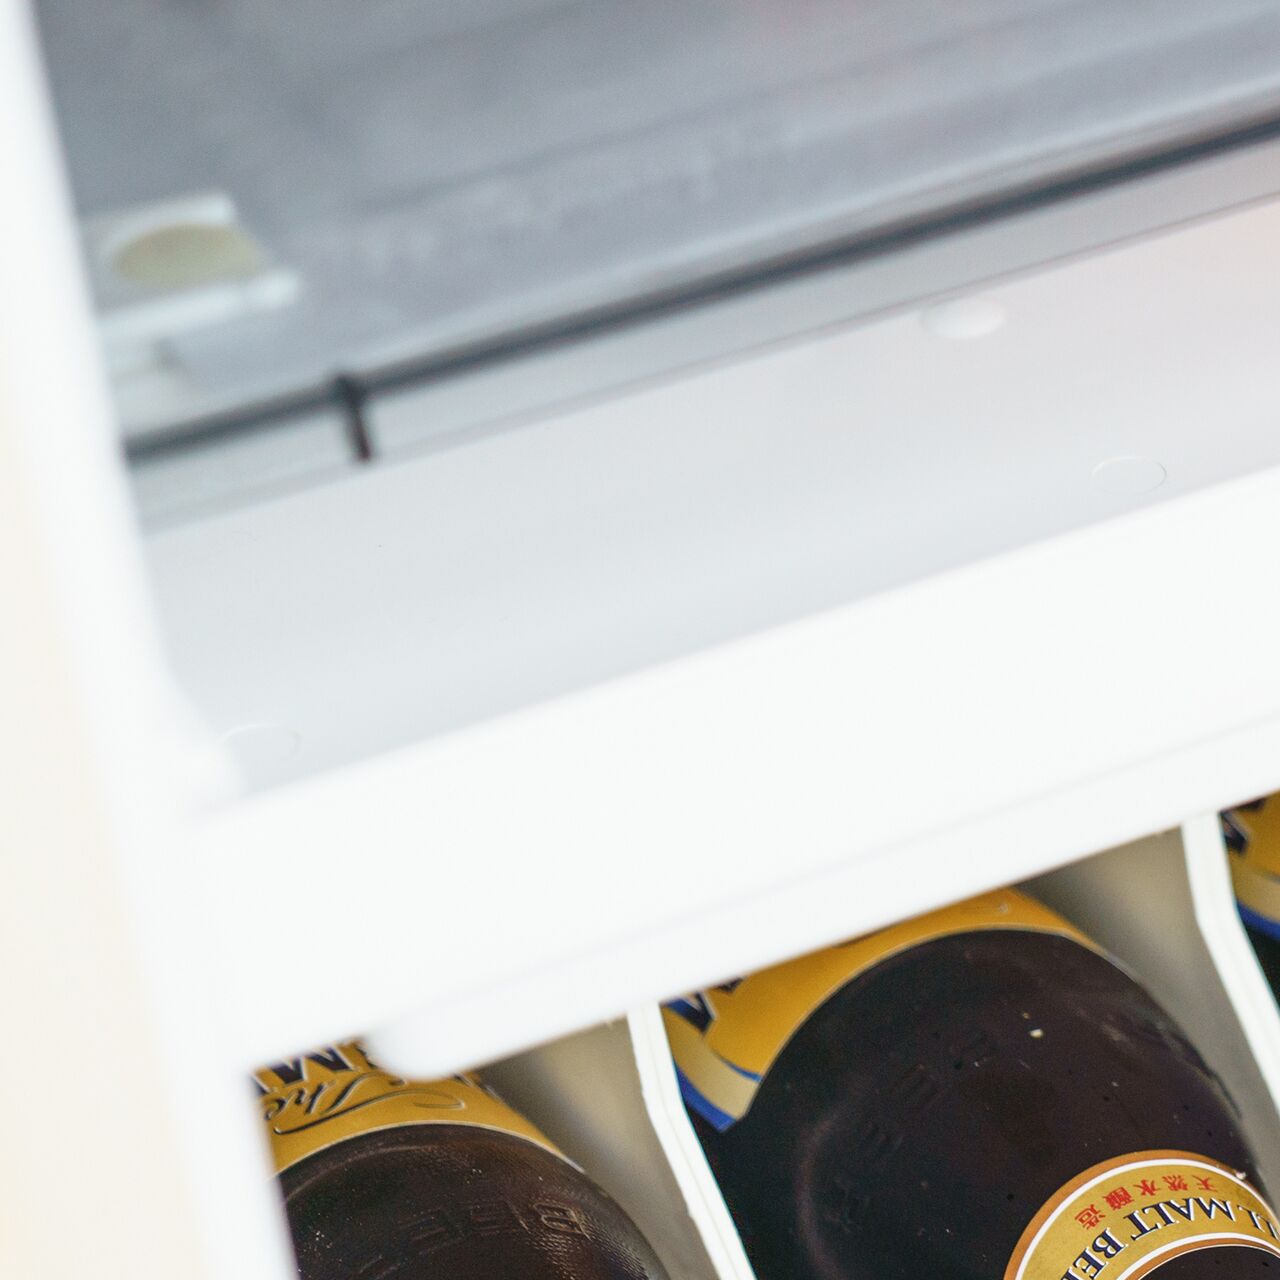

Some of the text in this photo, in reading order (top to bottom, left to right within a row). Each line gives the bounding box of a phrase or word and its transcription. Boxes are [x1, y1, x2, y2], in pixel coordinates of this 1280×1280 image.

[1074, 1174, 1215, 1231] 天然水醸造
[1122, 1195, 1234, 1241] MALT
